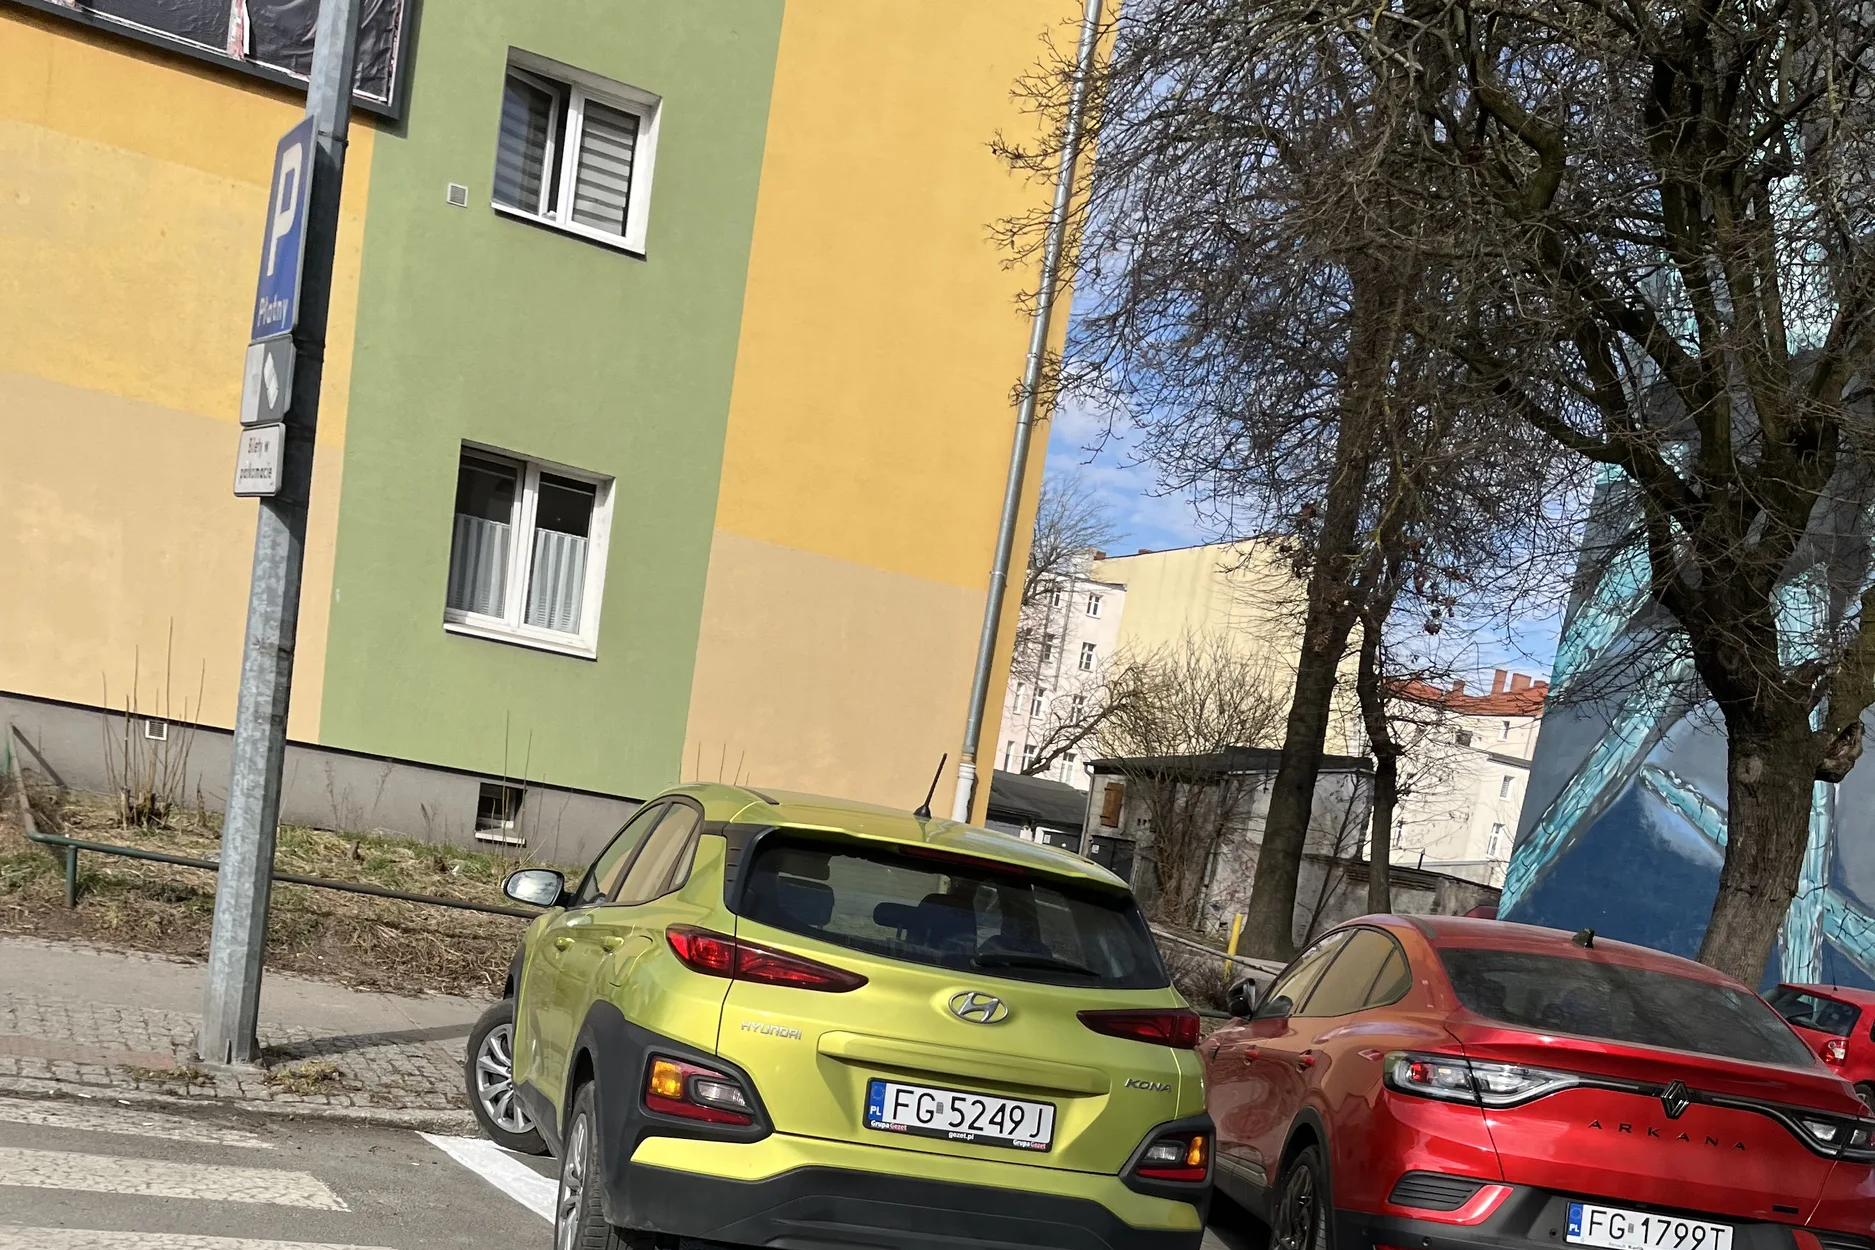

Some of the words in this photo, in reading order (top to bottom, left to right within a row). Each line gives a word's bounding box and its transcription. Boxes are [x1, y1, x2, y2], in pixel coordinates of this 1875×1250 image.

[267, 142, 302, 277] P
[741, 1021, 802, 1040] HYUNDAI
[1124, 1078, 1172, 1093] KONA
[869, 1105, 882, 1116] PL
[892, 1088, 936, 1124] FG
[948, 1096, 1043, 1138] 5249J
[870, 1119, 890, 1130] Grupa
[889, 1122, 908, 1132] Gezet
[948, 1131, 975, 1141] gezet.pl
[1588, 1120, 1746, 1151] ARKANA
[1012, 1139, 1031, 1149] Grupa
[1568, 1223, 1580, 1233] PL
[1588, 1209, 1626, 1240] FG
